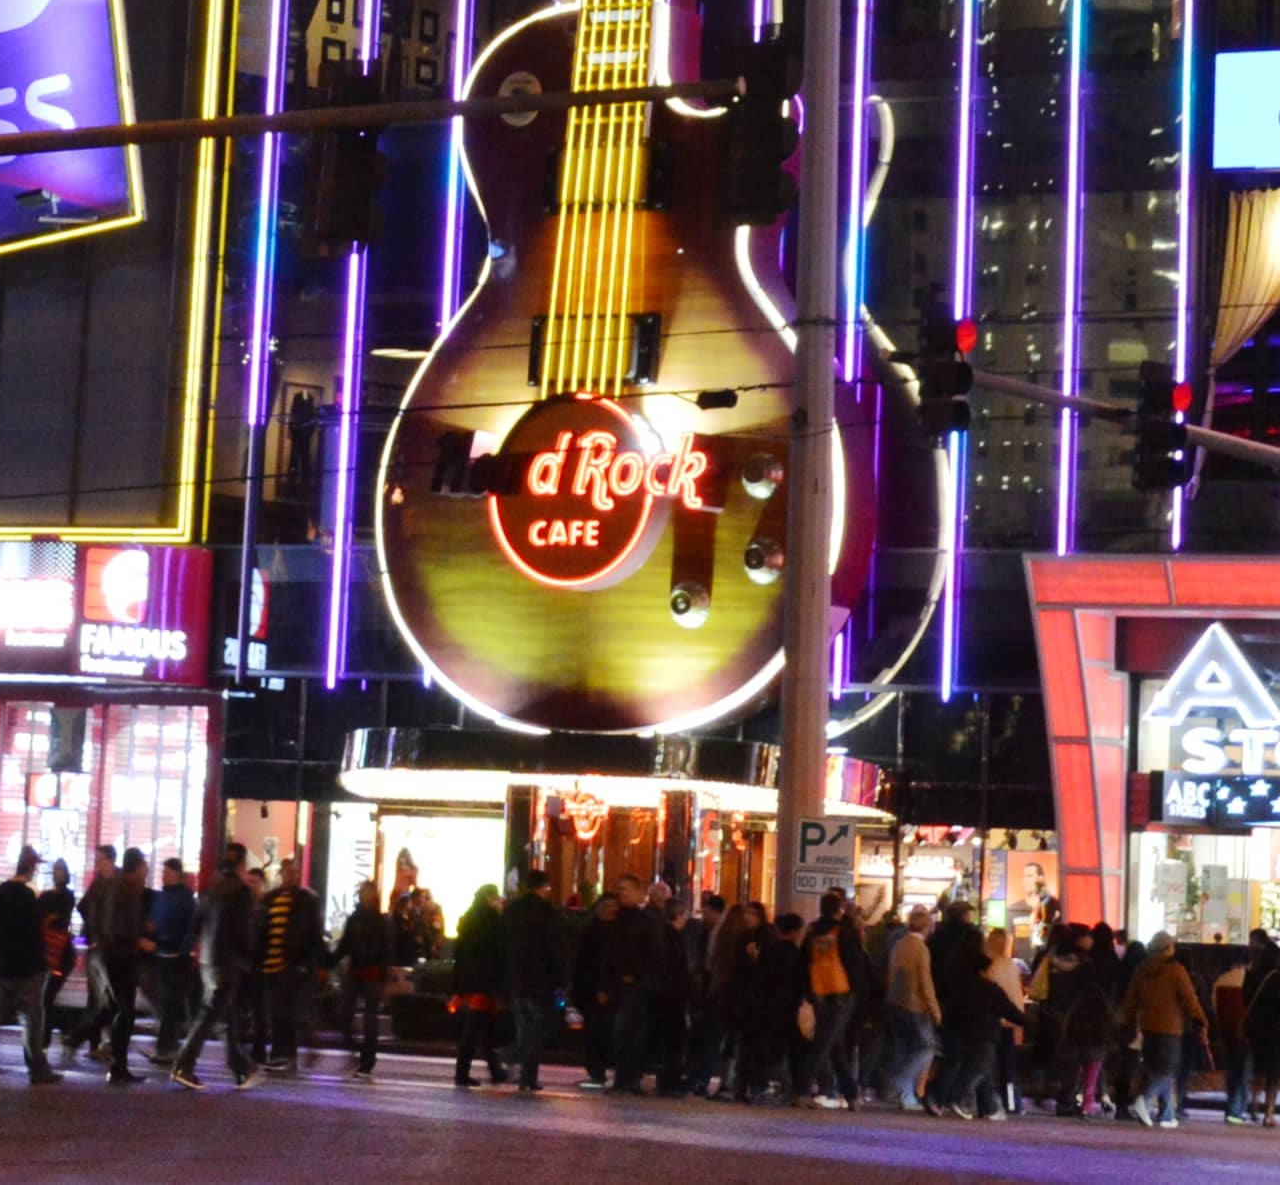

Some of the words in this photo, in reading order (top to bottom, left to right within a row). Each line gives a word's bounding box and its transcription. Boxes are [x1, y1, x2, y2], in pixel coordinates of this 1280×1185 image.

[573, 430, 708, 511] Rock
[528, 520, 600, 547] CAFE
[80, 623, 187, 661] FAMOUS
[1166, 780, 1211, 808] ABC
[1168, 805, 1207, 820] STORES
[800, 822, 826, 863] P
